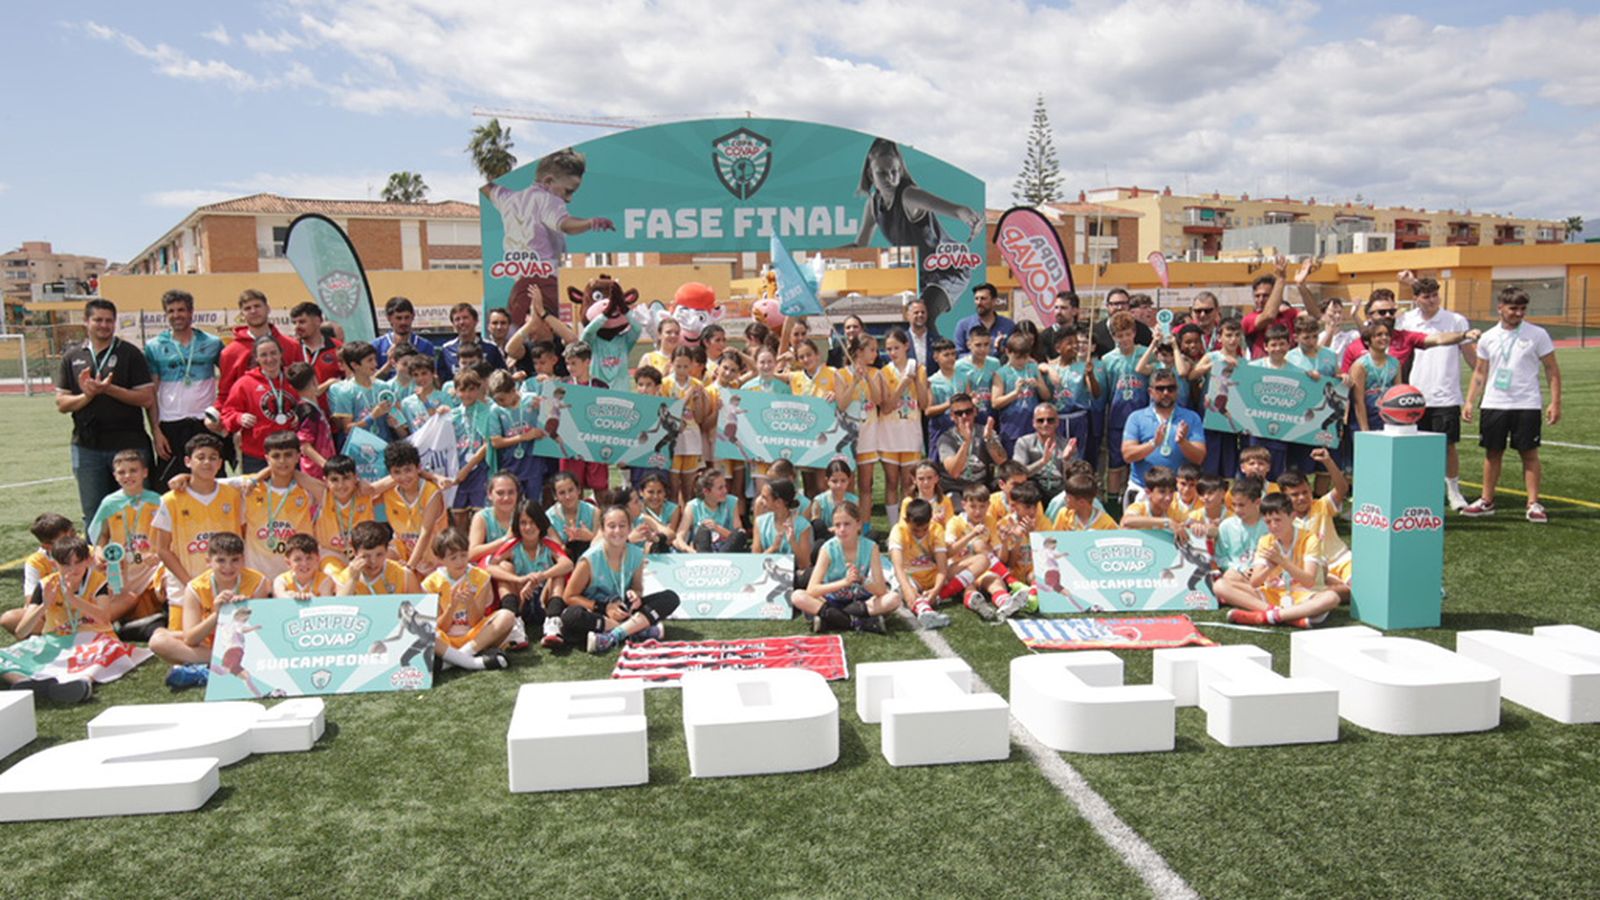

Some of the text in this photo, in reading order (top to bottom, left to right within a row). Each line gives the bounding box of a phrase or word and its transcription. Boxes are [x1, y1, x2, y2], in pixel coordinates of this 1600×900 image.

[731, 139, 754, 147] COPA
[725, 147, 761, 156] COVAP
[624, 205, 858, 239] FASE FINAL
[938, 243, 968, 254] COPA
[505, 251, 538, 261] COPA
[926, 253, 981, 270] COVAP
[491, 261, 552, 277] COVAP
[1261, 394, 1298, 408] COVAP
[1245, 408, 1306, 424] CAMPEONES
[594, 417, 632, 430] COVAP
[771, 420, 808, 432] COVAP
[577, 431, 641, 448] CAMPEONES
[755, 434, 821, 448] CAMPEONES
[1361, 503, 1381, 514] COPA
[1404, 507, 1430, 516] COPA
[1354, 512, 1389, 529] COVAP
[1392, 516, 1442, 531] COVAP
[1090, 545, 1154, 561] CAMPUS
[1101, 561, 1147, 573] COVAP
[1072, 578, 1179, 591] SUBCAMPEONES
[288, 614, 367, 637] CAMPUS
[298, 632, 357, 648] COVAP
[255, 652, 391, 672] SUBCAMPEONES
